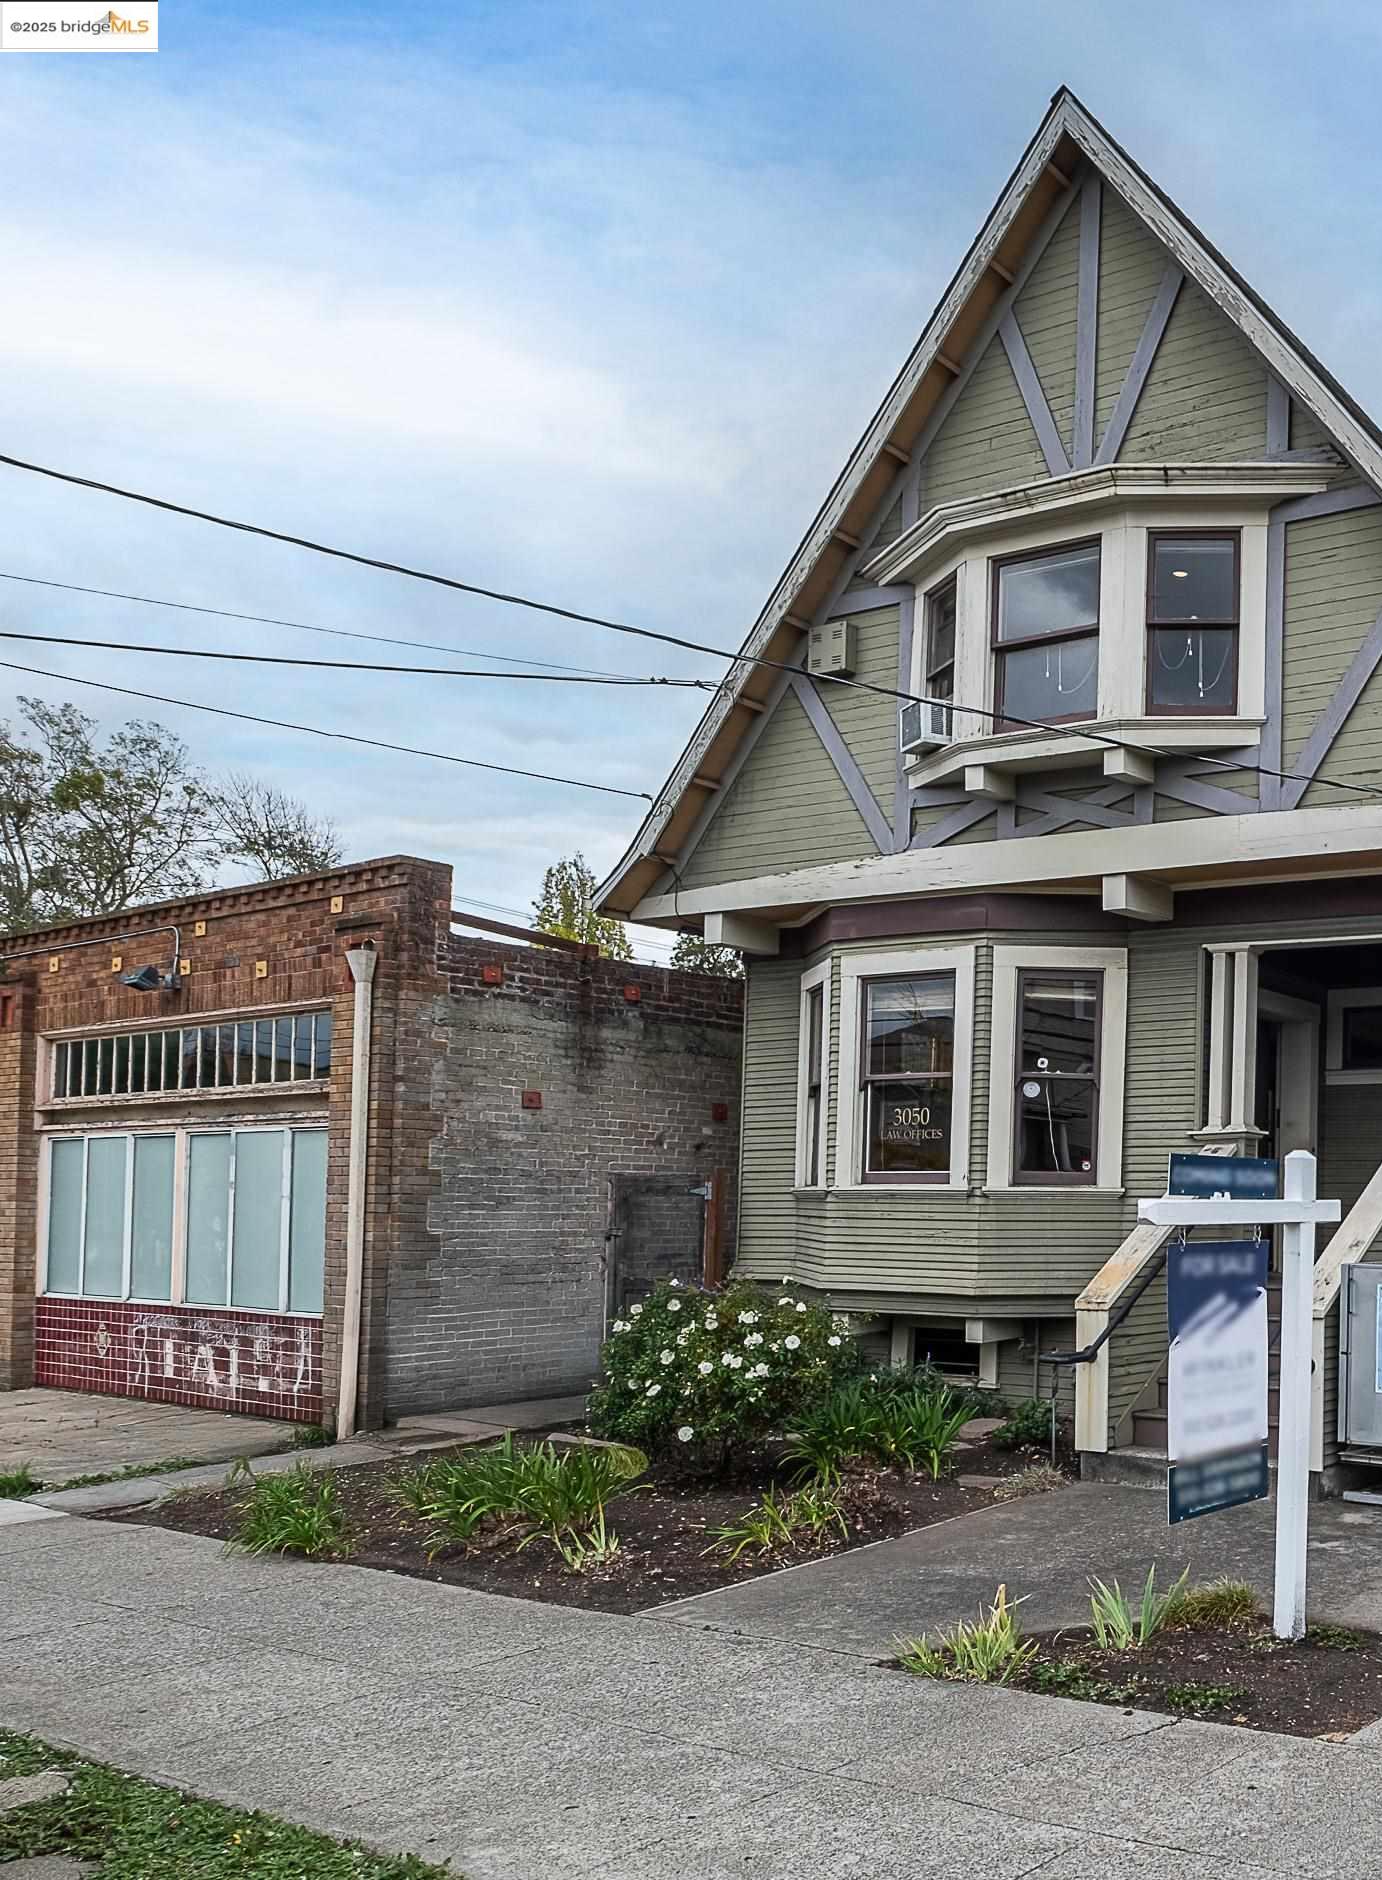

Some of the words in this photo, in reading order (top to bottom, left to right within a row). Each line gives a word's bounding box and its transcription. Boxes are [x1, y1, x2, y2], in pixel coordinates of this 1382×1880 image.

[893, 1107, 930, 1126] 3050
[881, 1129, 901, 1140] LAW
[903, 1129, 944, 1140] OFFICES
